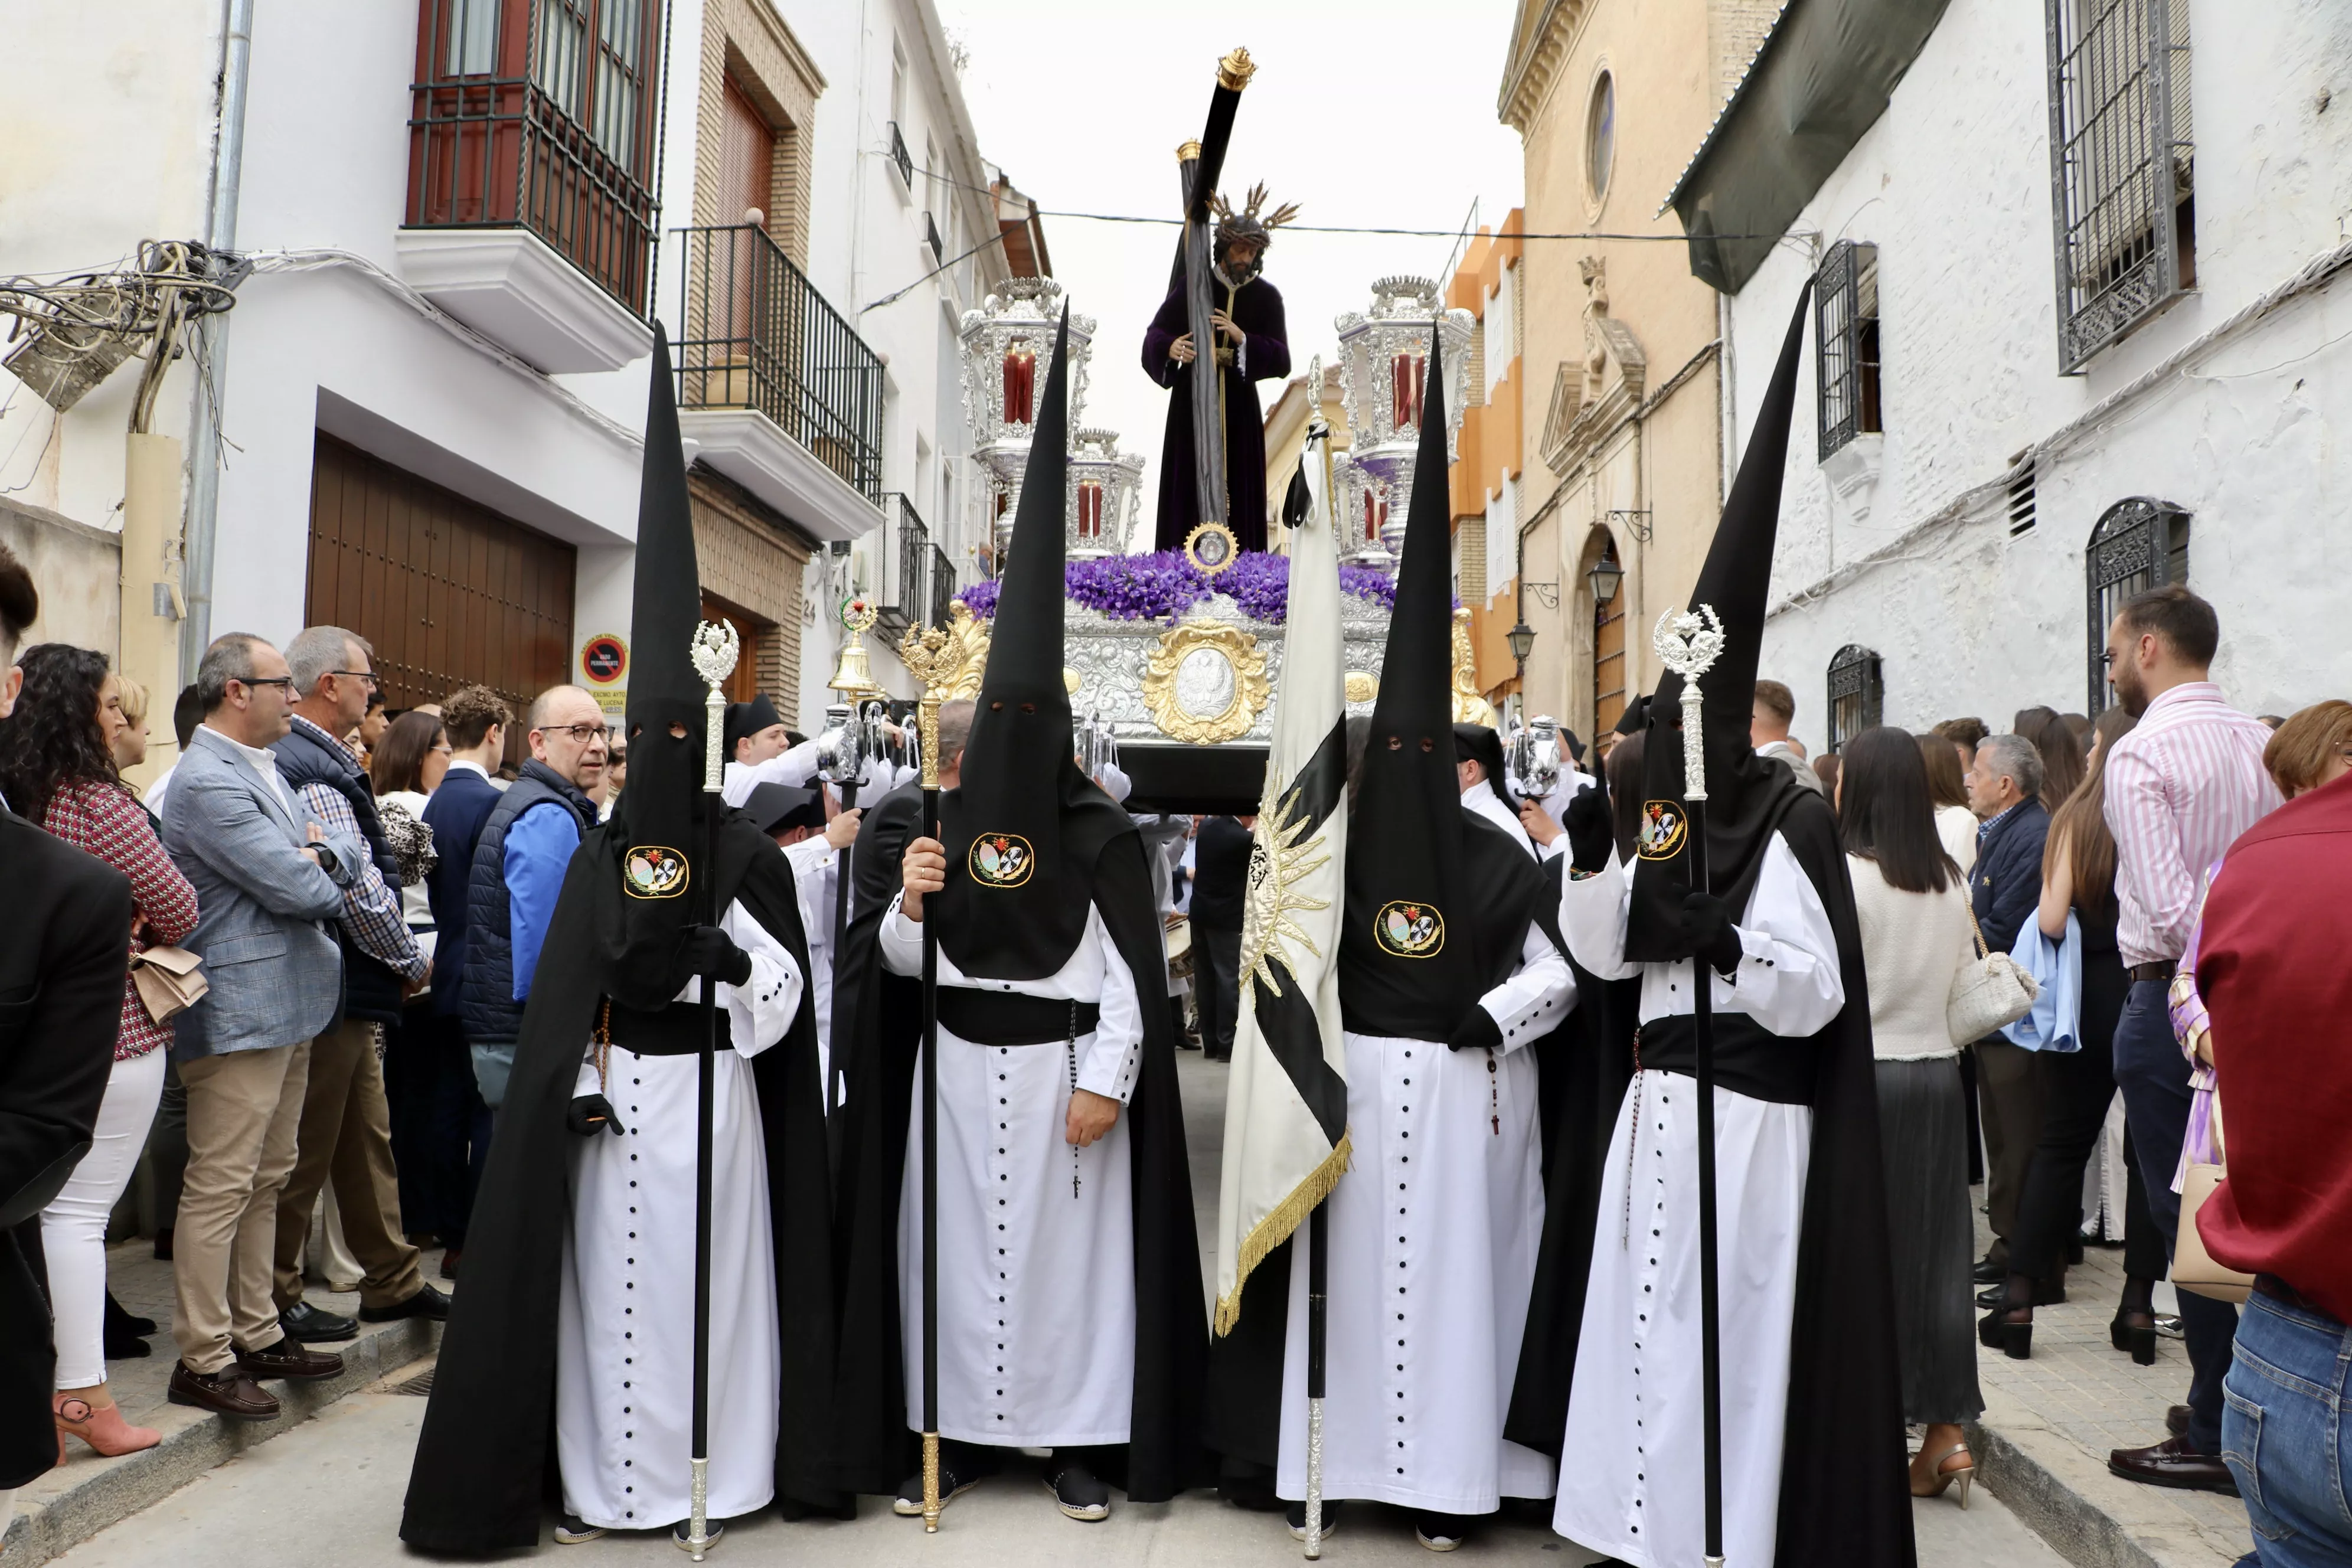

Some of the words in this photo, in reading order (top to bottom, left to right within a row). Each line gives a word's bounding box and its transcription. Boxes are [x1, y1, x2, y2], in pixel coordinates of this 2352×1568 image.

[803, 598, 815, 622] 24
[581, 637, 595, 654] SALIDA
[605, 633, 629, 653] VEHICULOS
